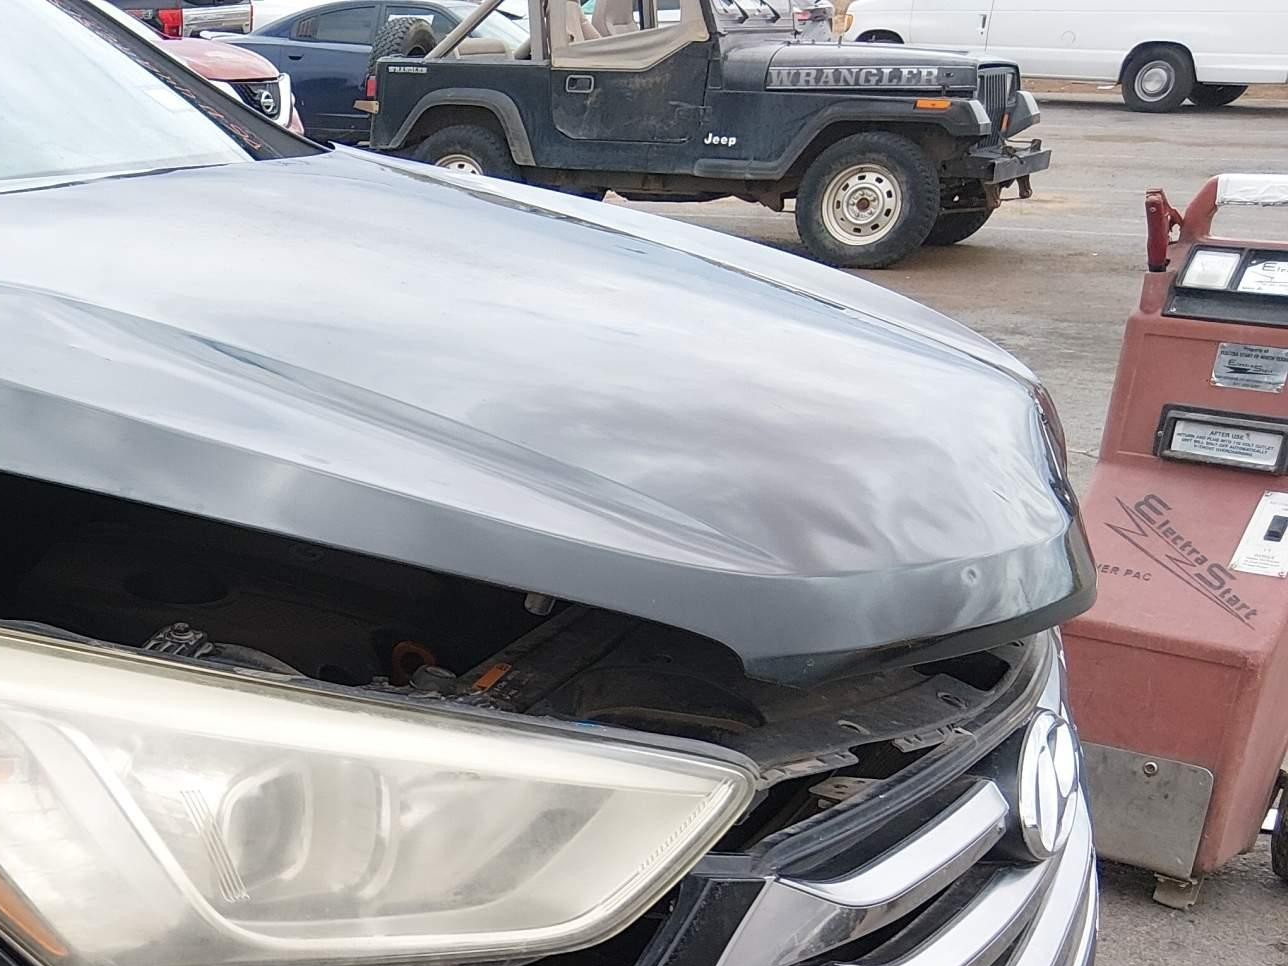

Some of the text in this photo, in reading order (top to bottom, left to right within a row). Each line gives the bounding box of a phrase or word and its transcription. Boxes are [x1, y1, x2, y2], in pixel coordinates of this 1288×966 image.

[768, 67, 939, 87] WRANGLER
[703, 132, 737, 147] Jeep
[1209, 430, 1230, 438] AFTER
[1123, 568, 1153, 582] PAC
